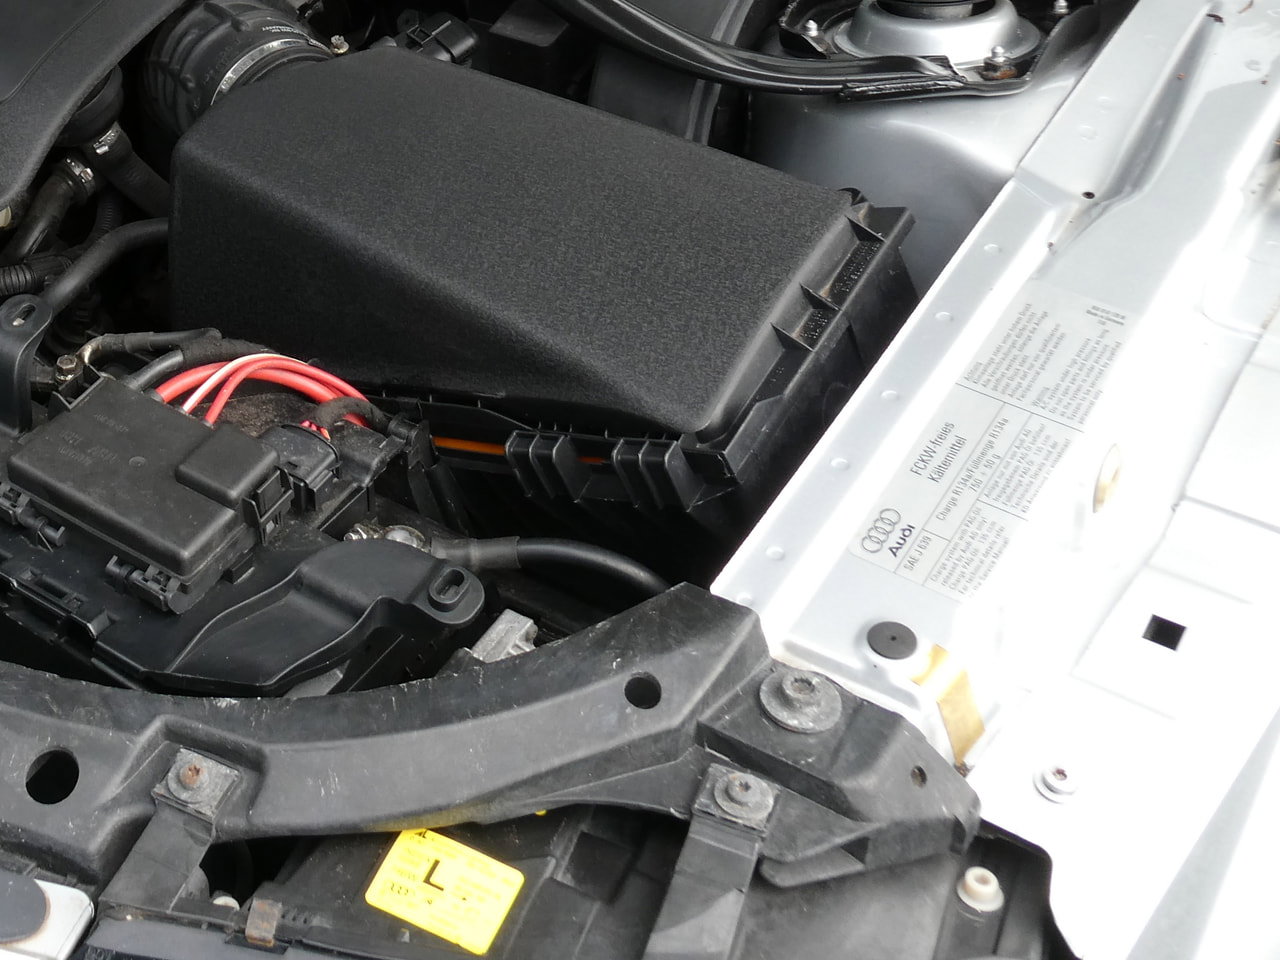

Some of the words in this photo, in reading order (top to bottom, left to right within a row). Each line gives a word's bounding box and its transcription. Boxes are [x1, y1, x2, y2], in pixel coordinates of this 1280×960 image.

[909, 420, 954, 475] FCKW-freies
[927, 434, 967, 482] Kältemittel
[886, 523, 915, 554] Audi
[422, 858, 445, 892] L
